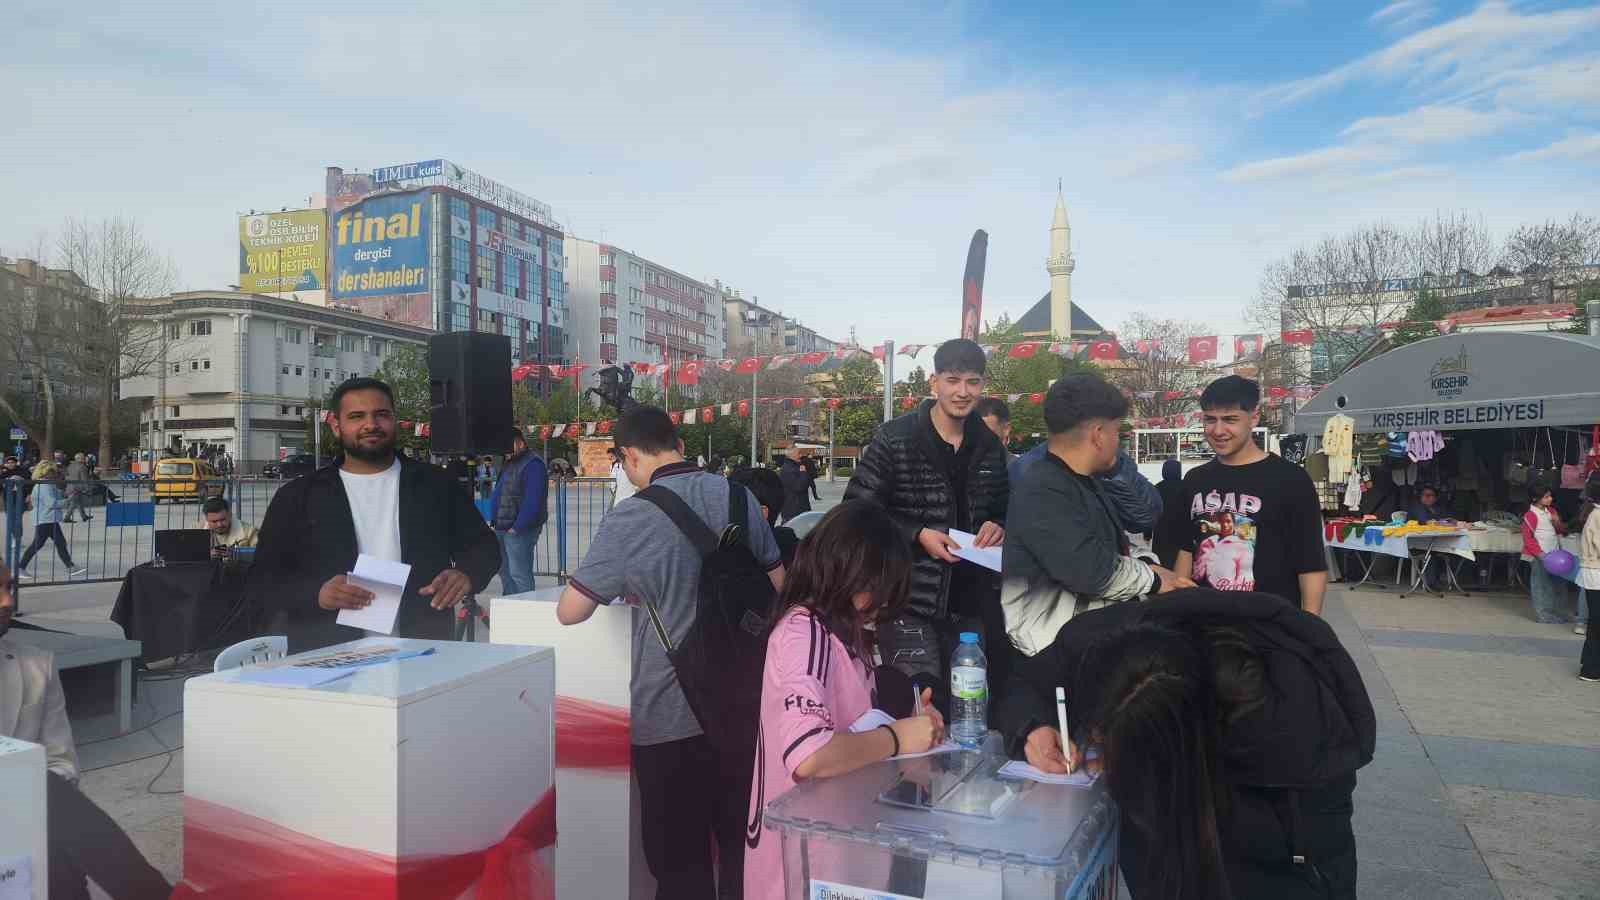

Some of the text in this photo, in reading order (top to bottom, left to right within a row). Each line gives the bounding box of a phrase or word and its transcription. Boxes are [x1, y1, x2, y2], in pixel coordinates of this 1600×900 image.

[336, 203, 422, 246] final
[354, 246, 393, 264] dergisi
[337, 264, 425, 292] dershaneleri
[1373, 400, 1544, 430] KIRŞEHİR BELEDİYESİ
